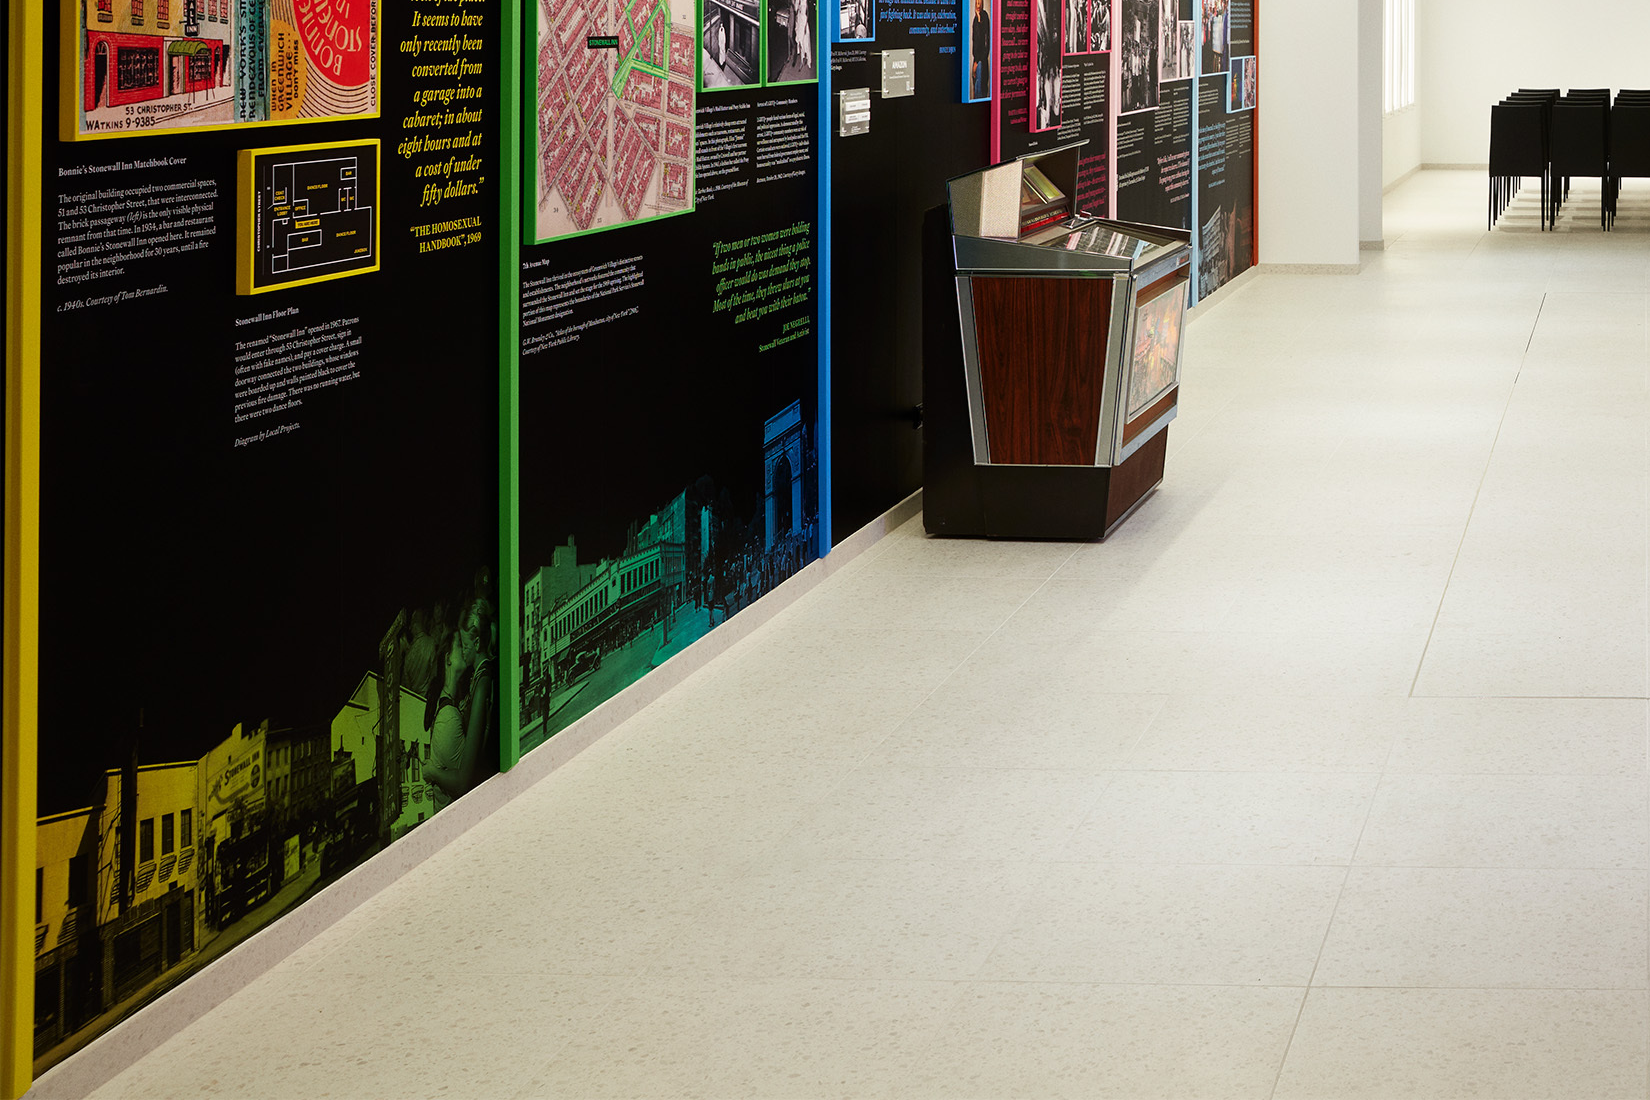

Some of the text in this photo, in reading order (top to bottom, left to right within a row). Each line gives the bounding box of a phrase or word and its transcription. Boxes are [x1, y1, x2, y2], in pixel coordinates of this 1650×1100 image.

[411, 9, 483, 27] It seems to have
[399, 33, 483, 57] only recently been
[277, 33, 285, 112] GREENWICH
[411, 57, 483, 80] converted from
[125, 102, 193, 115] 53 CHRISTOPHER ST.
[125, 116, 156, 128] 9-9385
[58, 156, 187, 177] Bonnie’s Stonewall Inn Matchbook Cover
[409, 215, 482, 237] “THE HOMOSEXUAL
[419, 231, 482, 253] HANDBOOK”, 1969
[235, 306, 299, 326] Stonewall Inn Floor Plan
